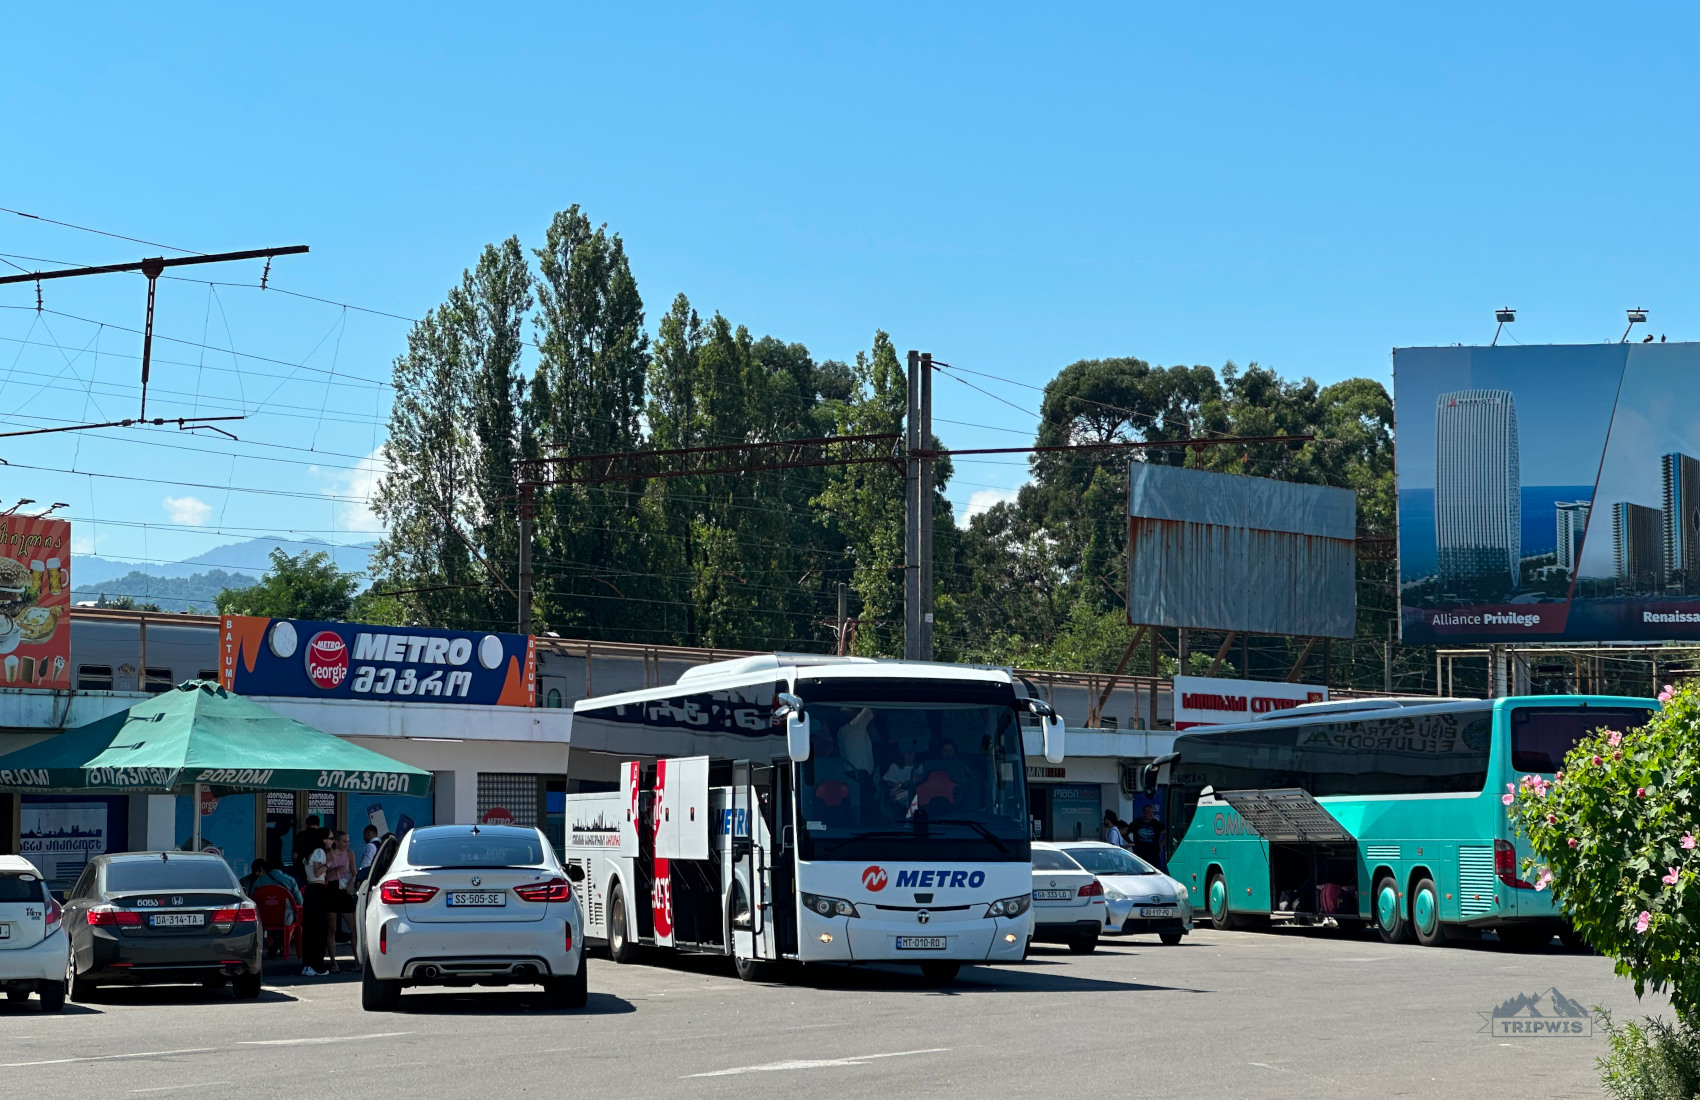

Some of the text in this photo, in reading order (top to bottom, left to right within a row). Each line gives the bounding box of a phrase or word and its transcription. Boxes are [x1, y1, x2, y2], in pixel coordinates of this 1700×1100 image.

[1432, 611, 1541, 627] Alliance Privilege
[1643, 610, 1700, 623] Renaissa
[317, 640, 341, 649] METRO
[352, 633, 473, 666] METRO
[310, 662, 347, 685] Georgia
[351, 666, 473, 698] მეტრო
[90, 766, 169, 785] ბორჯომი
[196, 769, 273, 784] BORJOMI
[317, 770, 410, 793] ბორჯომი
[896, 871, 986, 888] METRO
[455, 894, 499, 904] SS-505-SE
